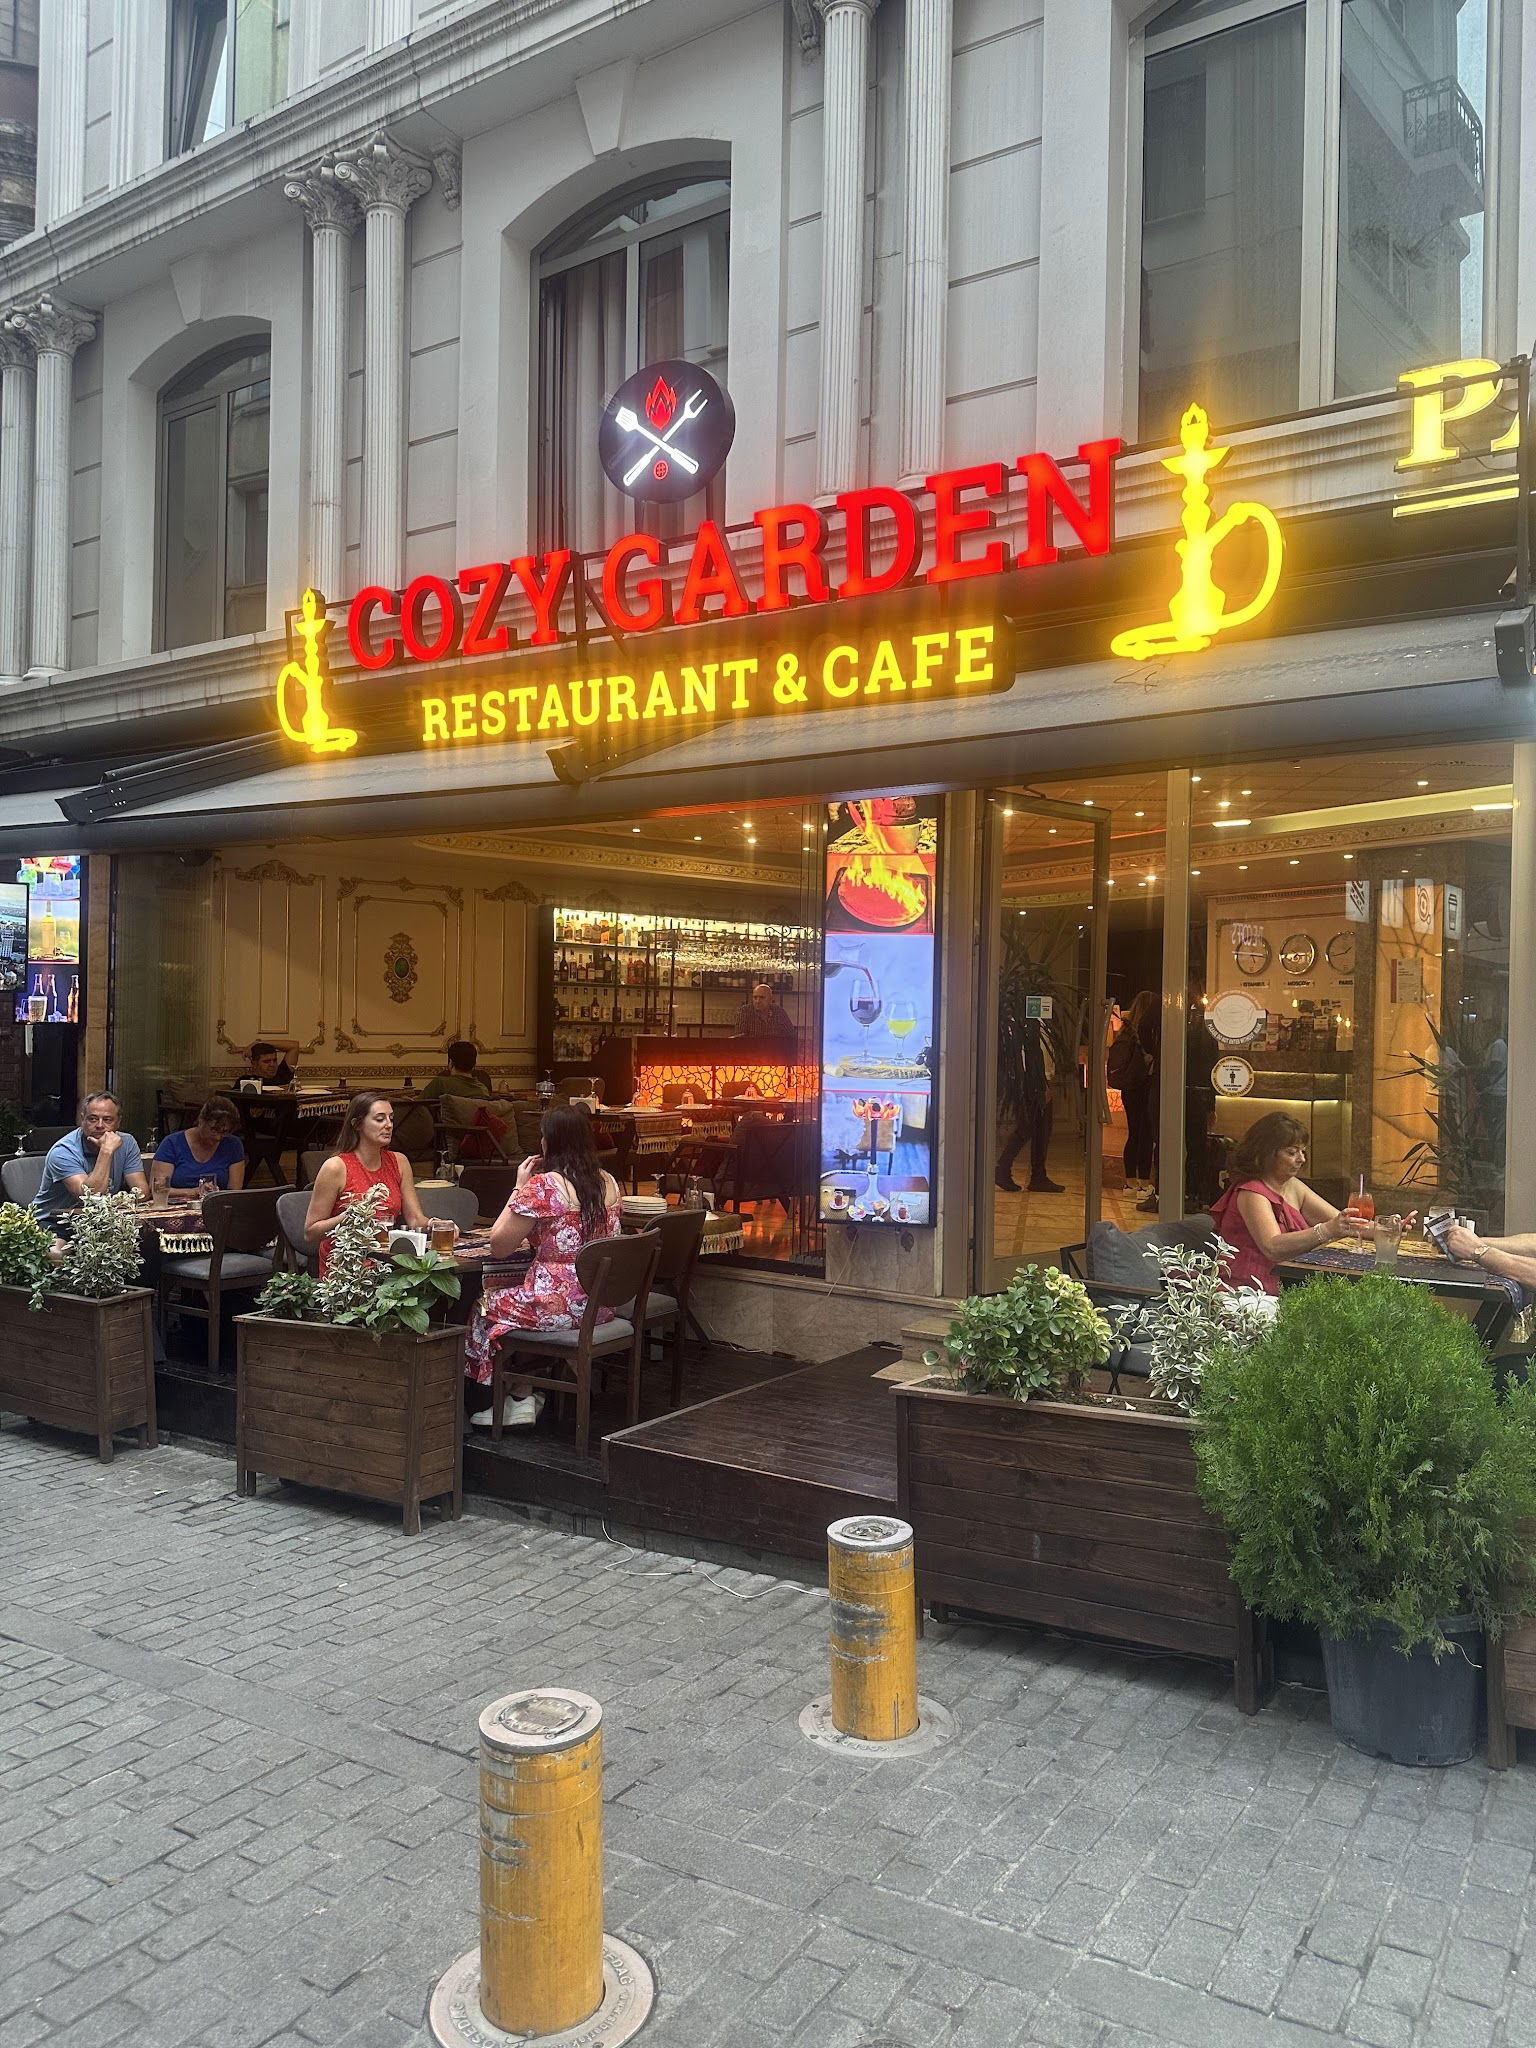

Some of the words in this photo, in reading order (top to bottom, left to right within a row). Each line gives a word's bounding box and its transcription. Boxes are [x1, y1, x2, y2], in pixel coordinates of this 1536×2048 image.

[1397, 357, 1521, 472] P
[347, 549, 573, 671] COZY
[601, 437, 1122, 632] GARDEN
[422, 657, 758, 743] RESTAURANT
[773, 652, 808, 705] &
[822, 625, 994, 700] CAFE
